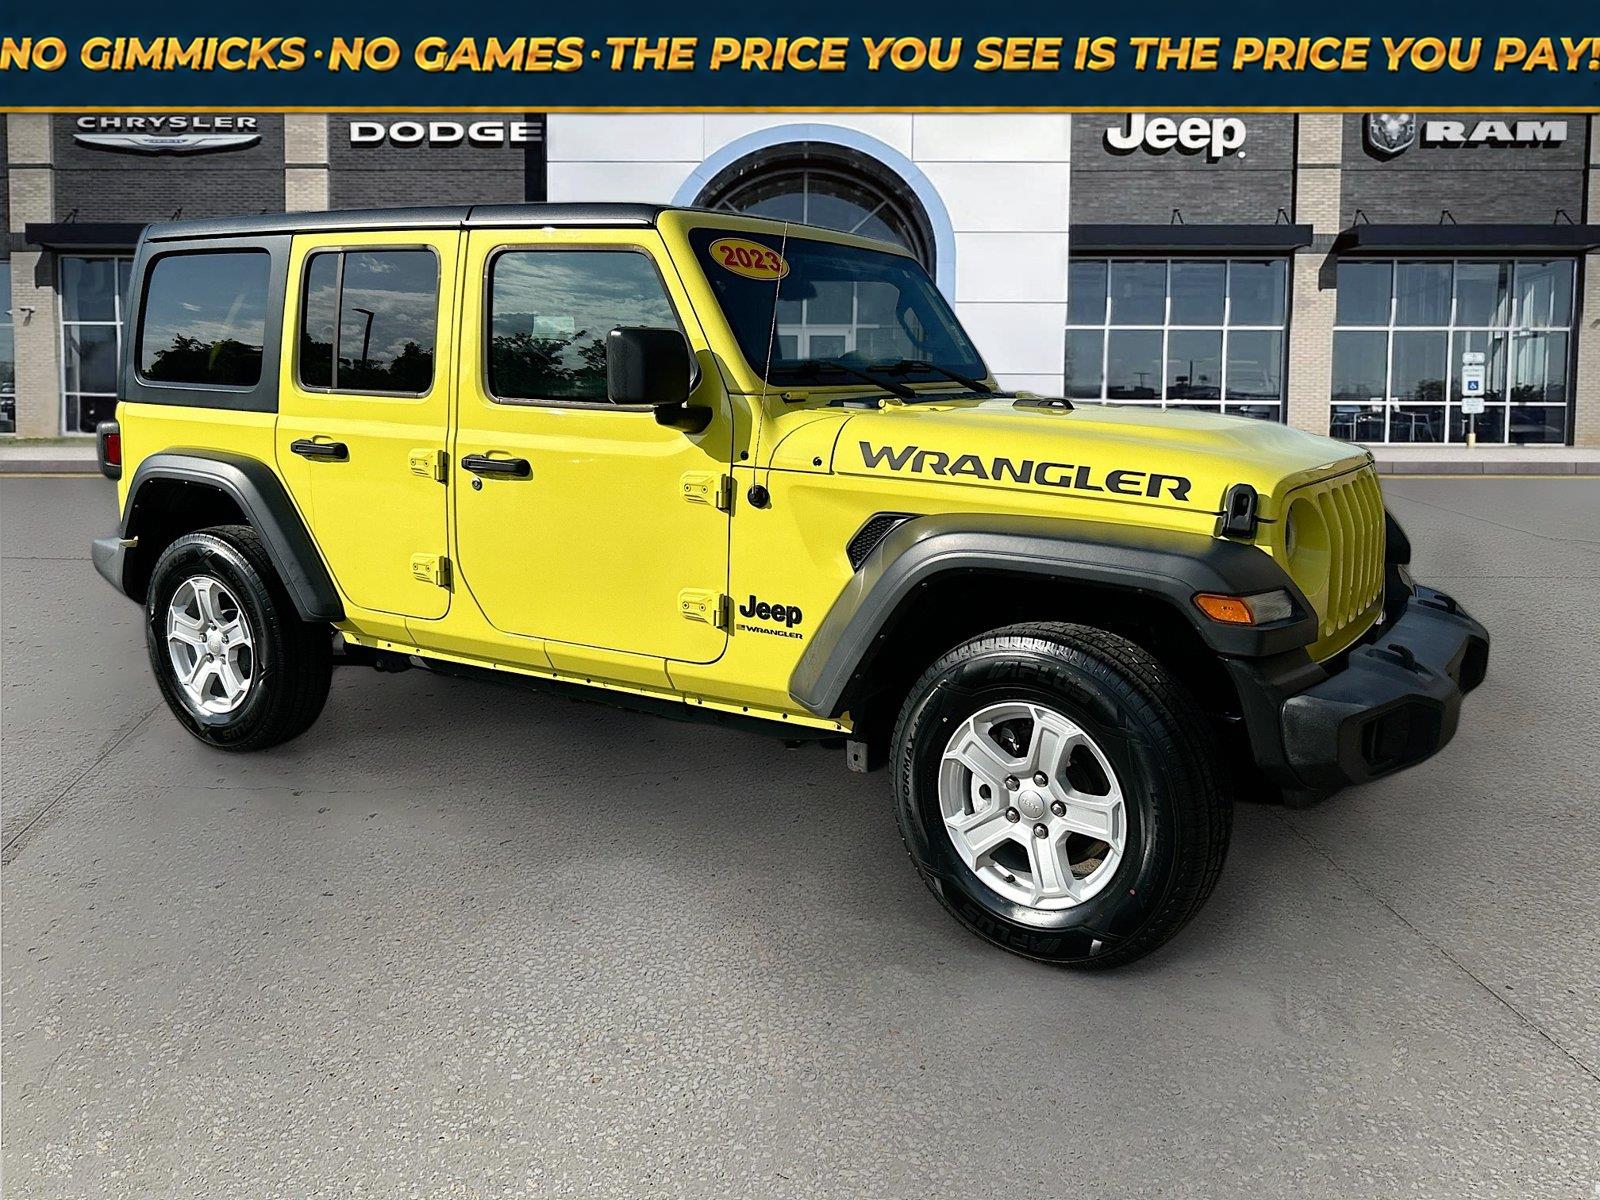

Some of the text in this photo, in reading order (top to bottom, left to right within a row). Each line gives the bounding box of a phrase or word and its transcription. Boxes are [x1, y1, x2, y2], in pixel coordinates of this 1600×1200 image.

[76, 116, 257, 129] CHRYSLER
[350, 121, 543, 142] DODGE
[1425, 120, 1568, 141] RAM
[720, 245, 783, 272] 2023
[858, 440, 1193, 502] WRANGLER
[739, 594, 803, 628] Jeep
[746, 625, 803, 640] WRANGLER
